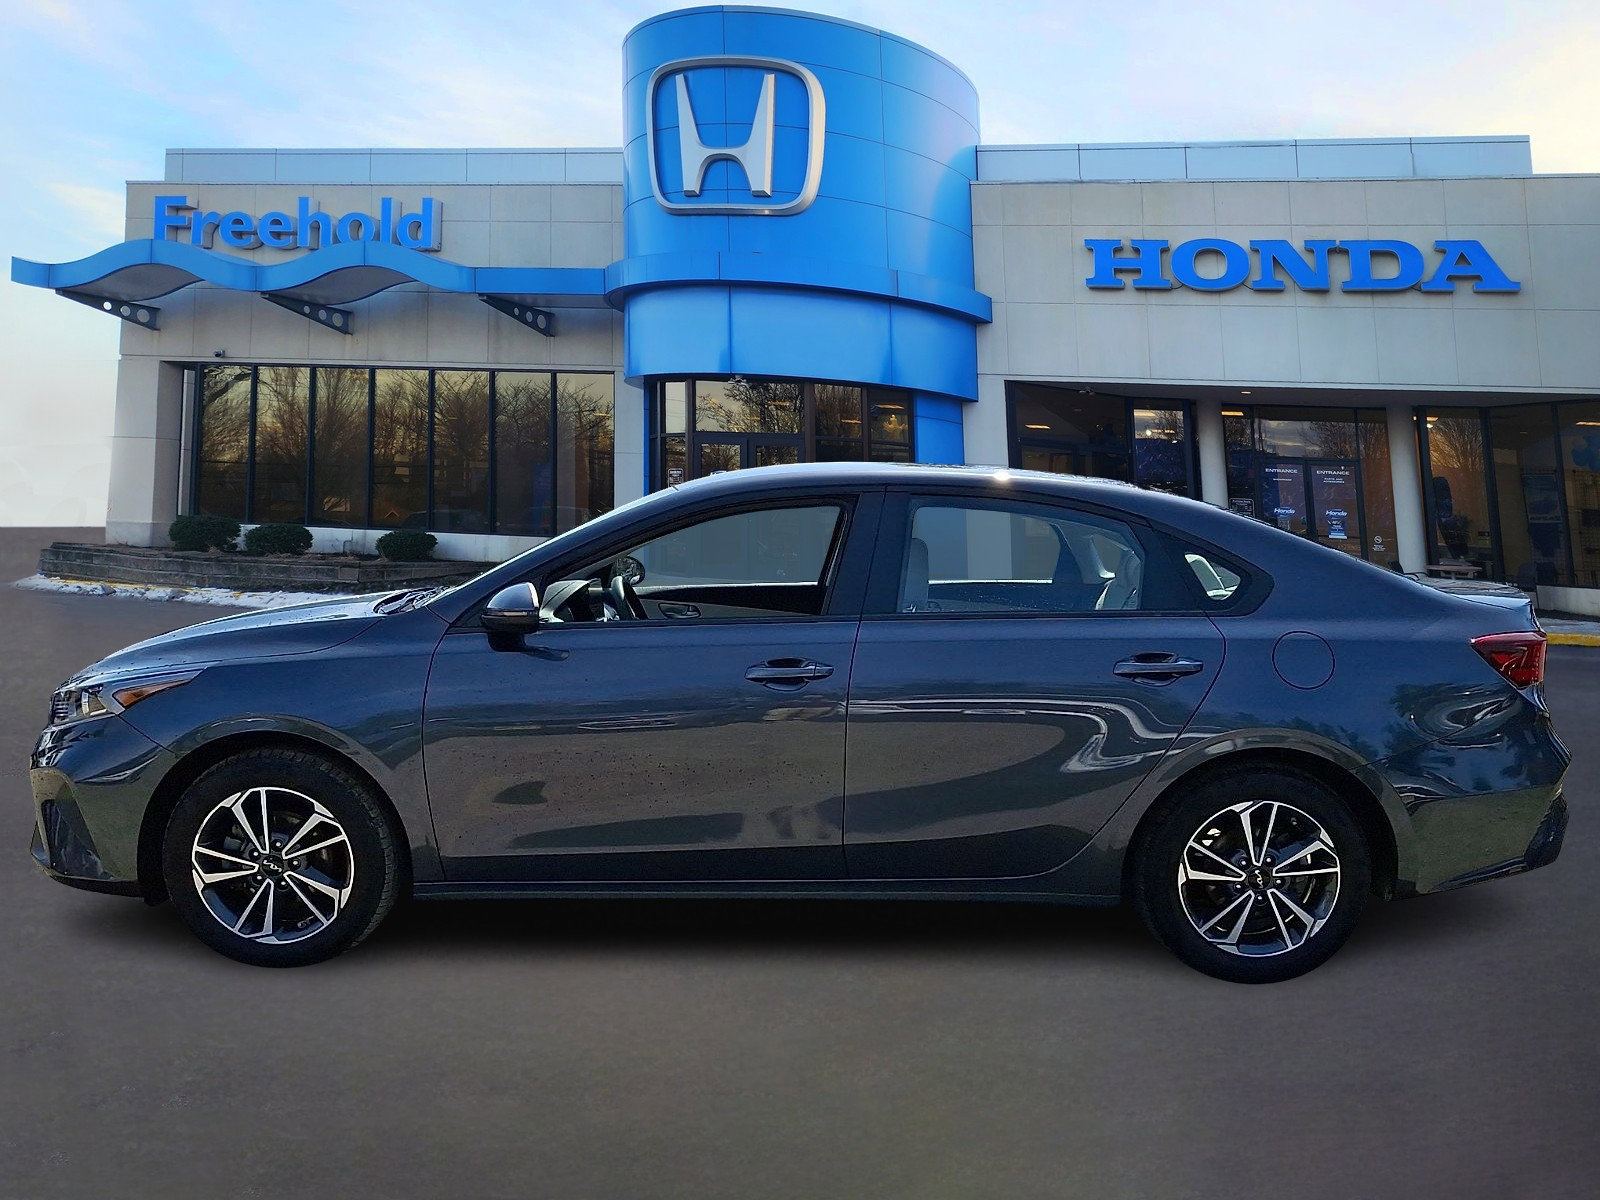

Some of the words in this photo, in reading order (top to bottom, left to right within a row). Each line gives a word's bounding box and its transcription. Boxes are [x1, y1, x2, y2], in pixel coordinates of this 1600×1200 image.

[154, 195, 441, 250] Freehold
[1084, 238, 1522, 294] HONDA
[1273, 507, 1296, 515] Honda
[1325, 509, 1348, 517] Honda
